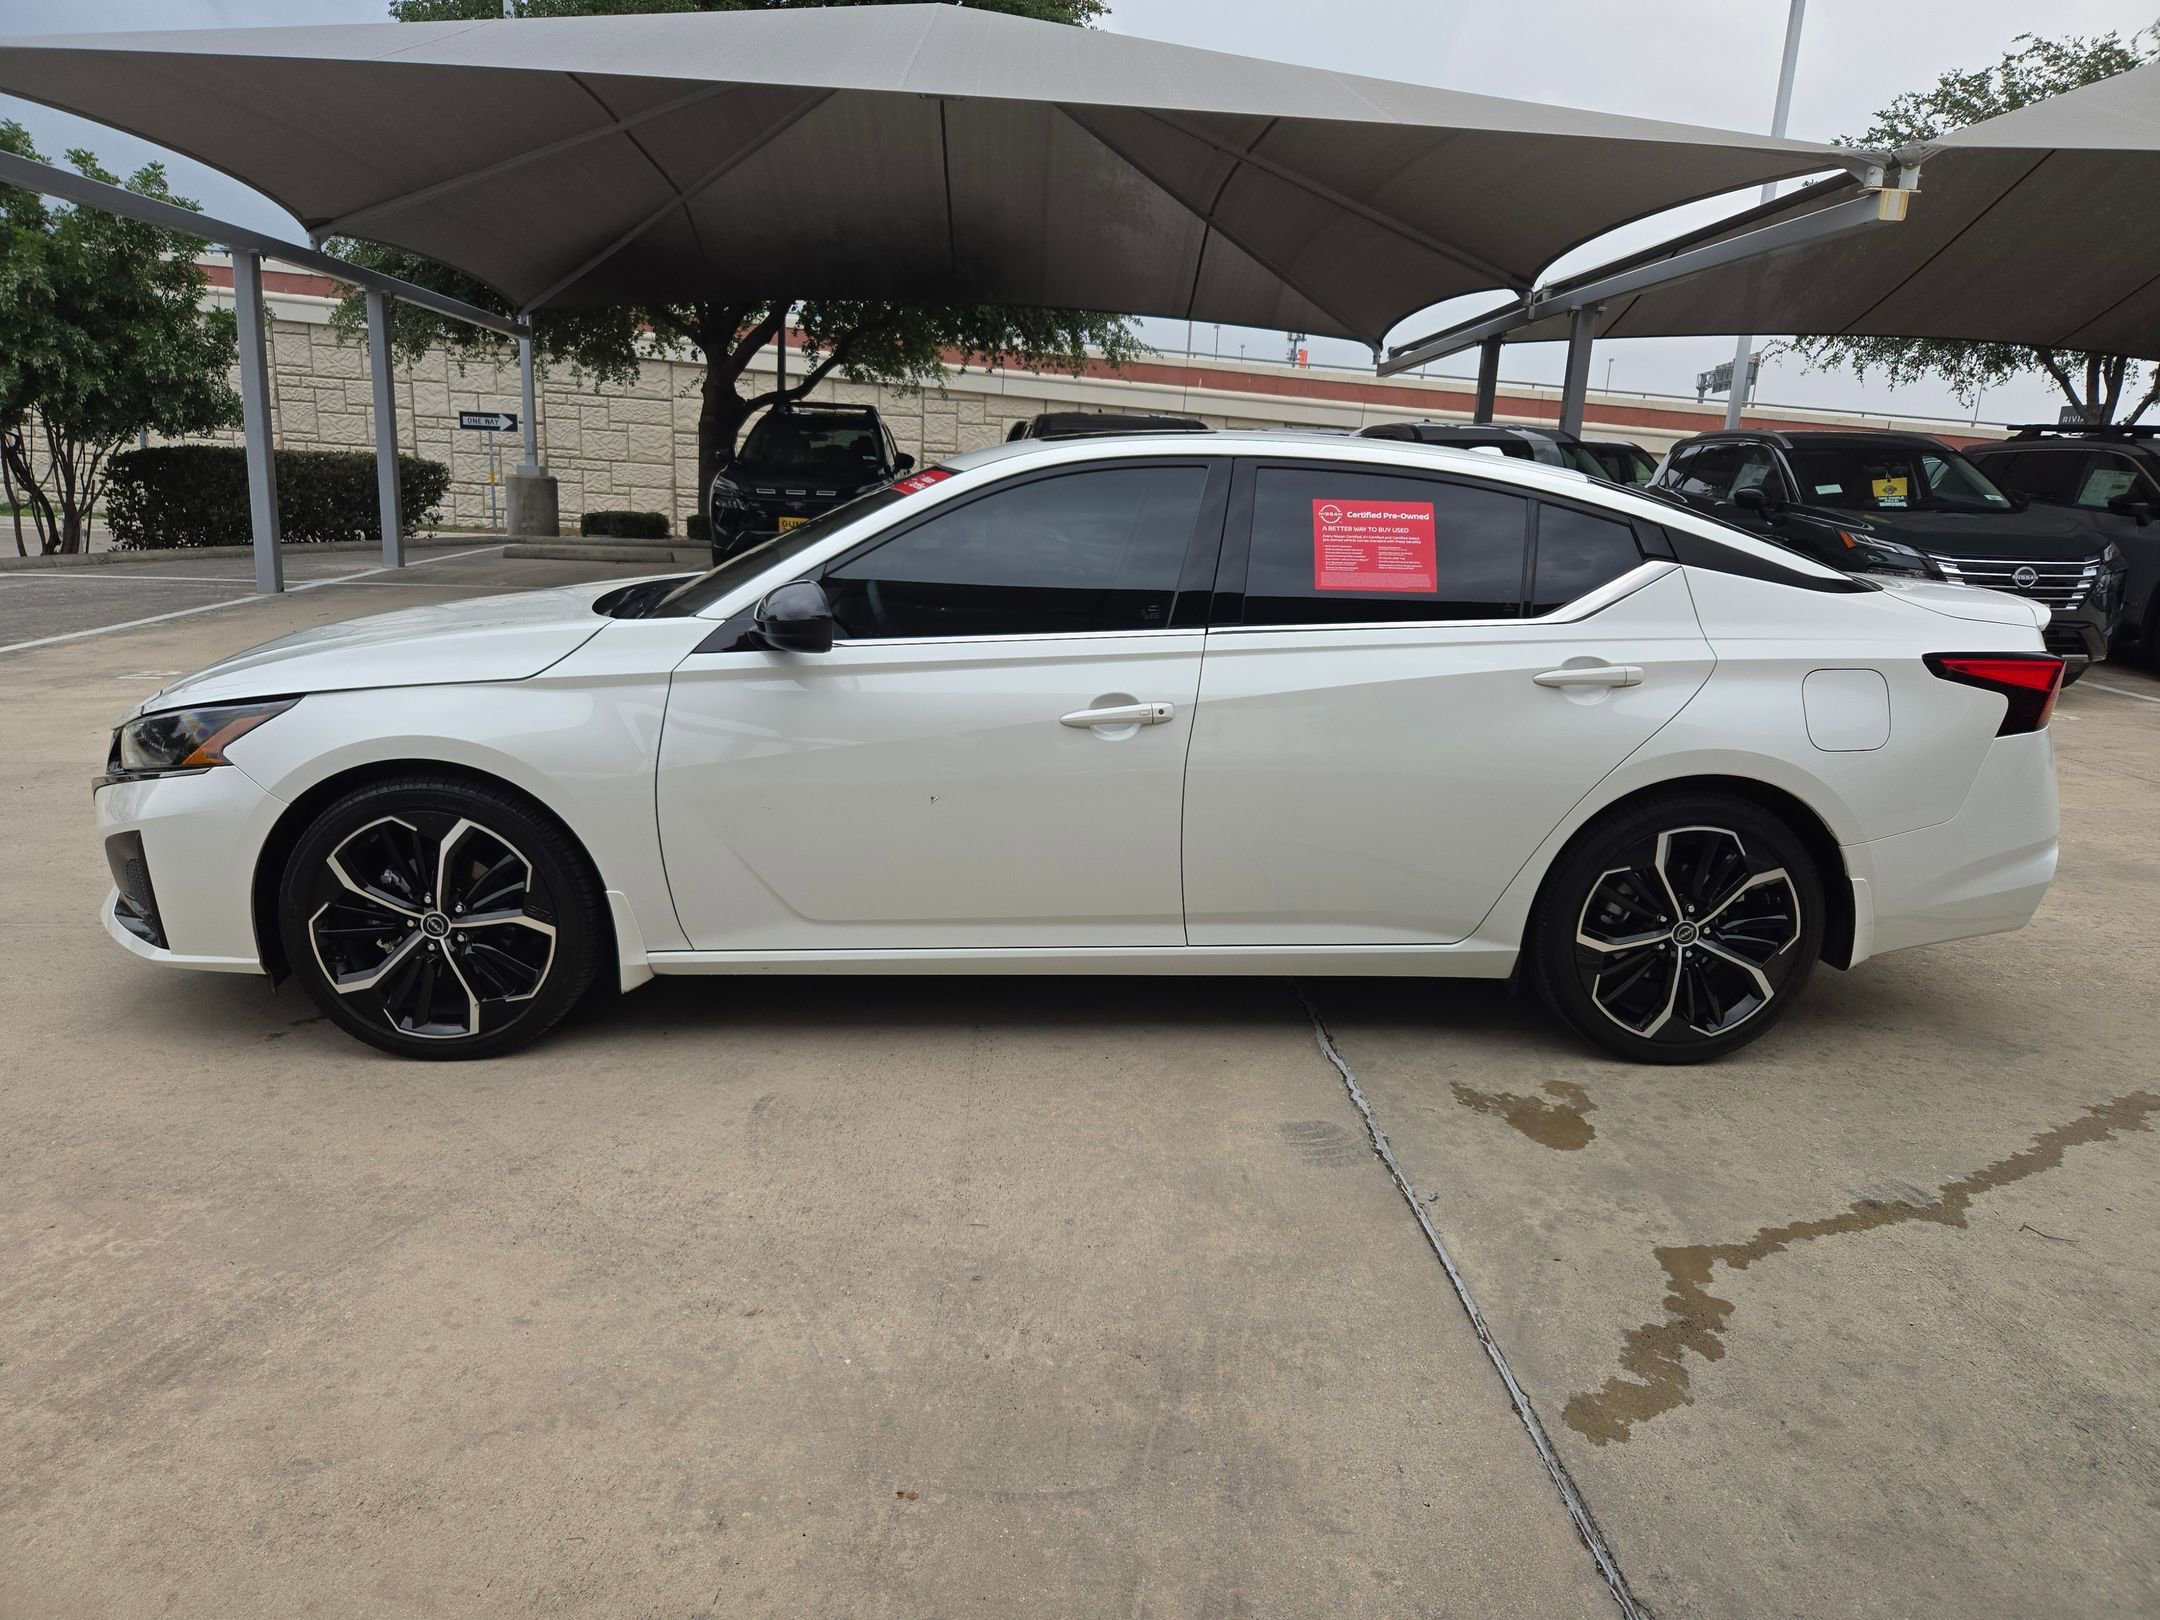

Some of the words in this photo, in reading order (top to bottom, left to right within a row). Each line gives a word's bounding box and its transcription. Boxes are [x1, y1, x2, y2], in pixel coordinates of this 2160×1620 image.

[467, 416, 482, 424] ONE
[484, 417, 499, 426] WAY
[1347, 511, 1382, 519] Certified
[1383, 512, 1430, 520] Pre-Owned
